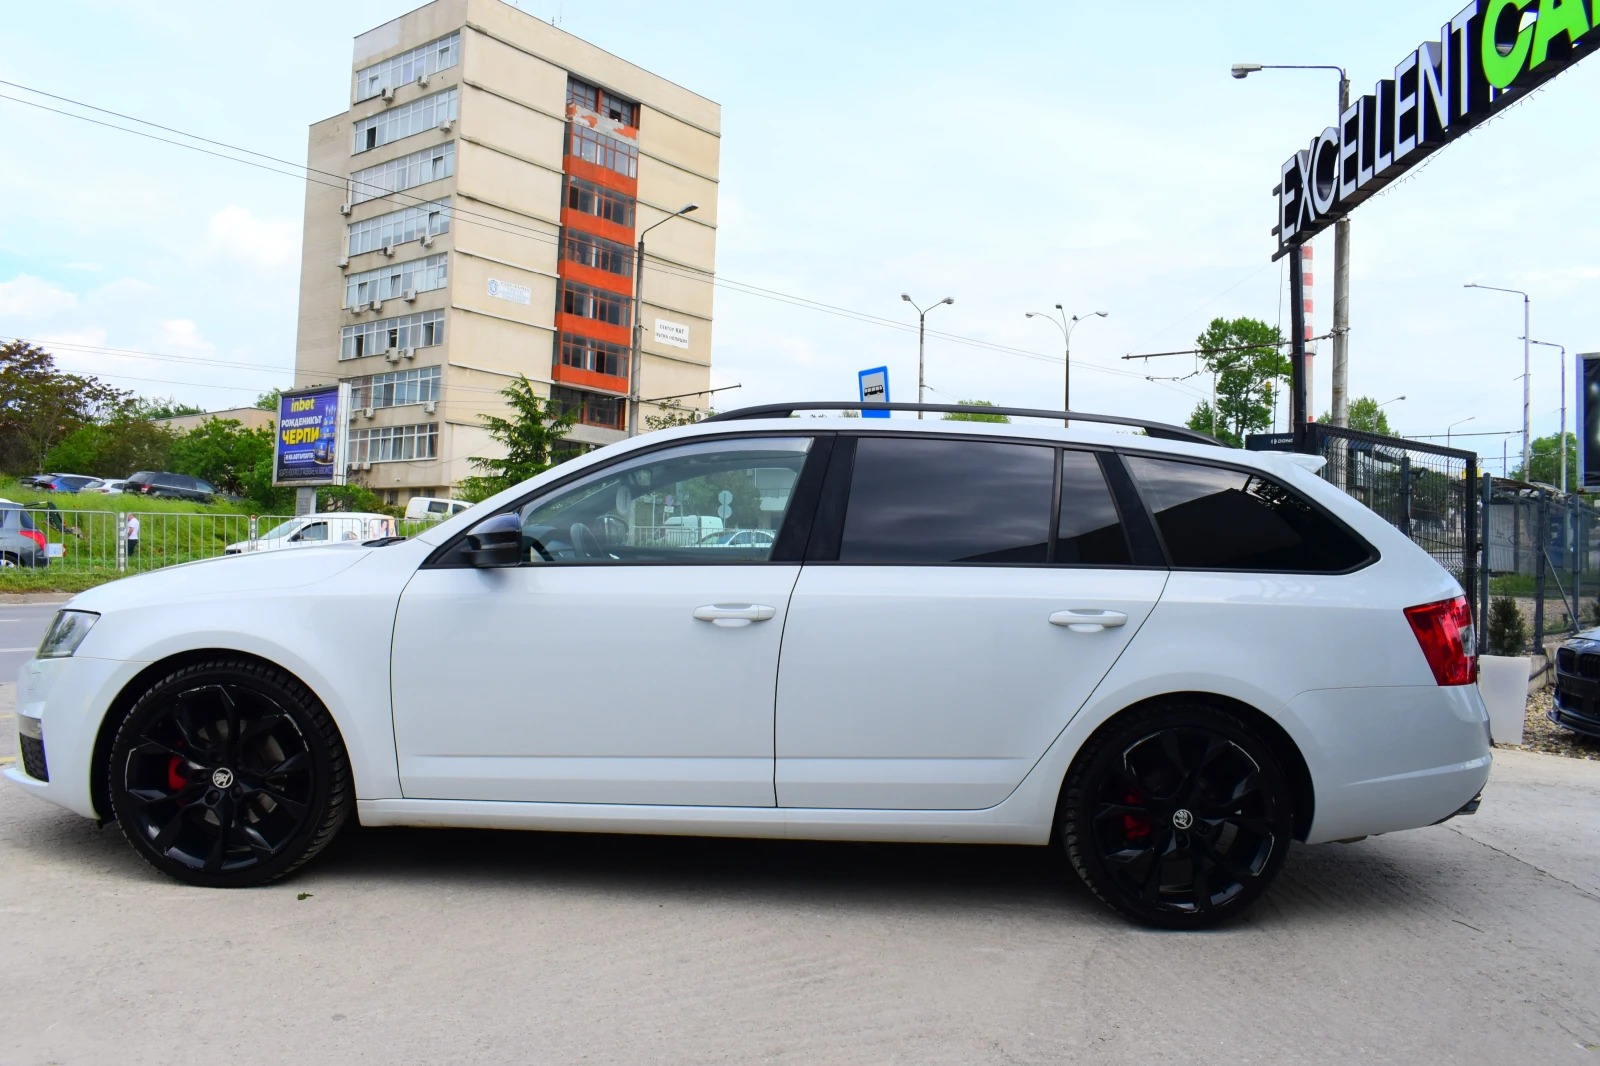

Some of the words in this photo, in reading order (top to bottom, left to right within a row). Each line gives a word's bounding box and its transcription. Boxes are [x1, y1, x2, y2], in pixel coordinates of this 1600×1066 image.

[1281, 0, 1478, 243] EXCELLENT
[1481, 0, 1600, 89] CA
[291, 397, 315, 412] inbet
[281, 415, 322, 427] РОЖДЕНИКЪТ
[282, 427, 320, 445] ЧЕРПИ
